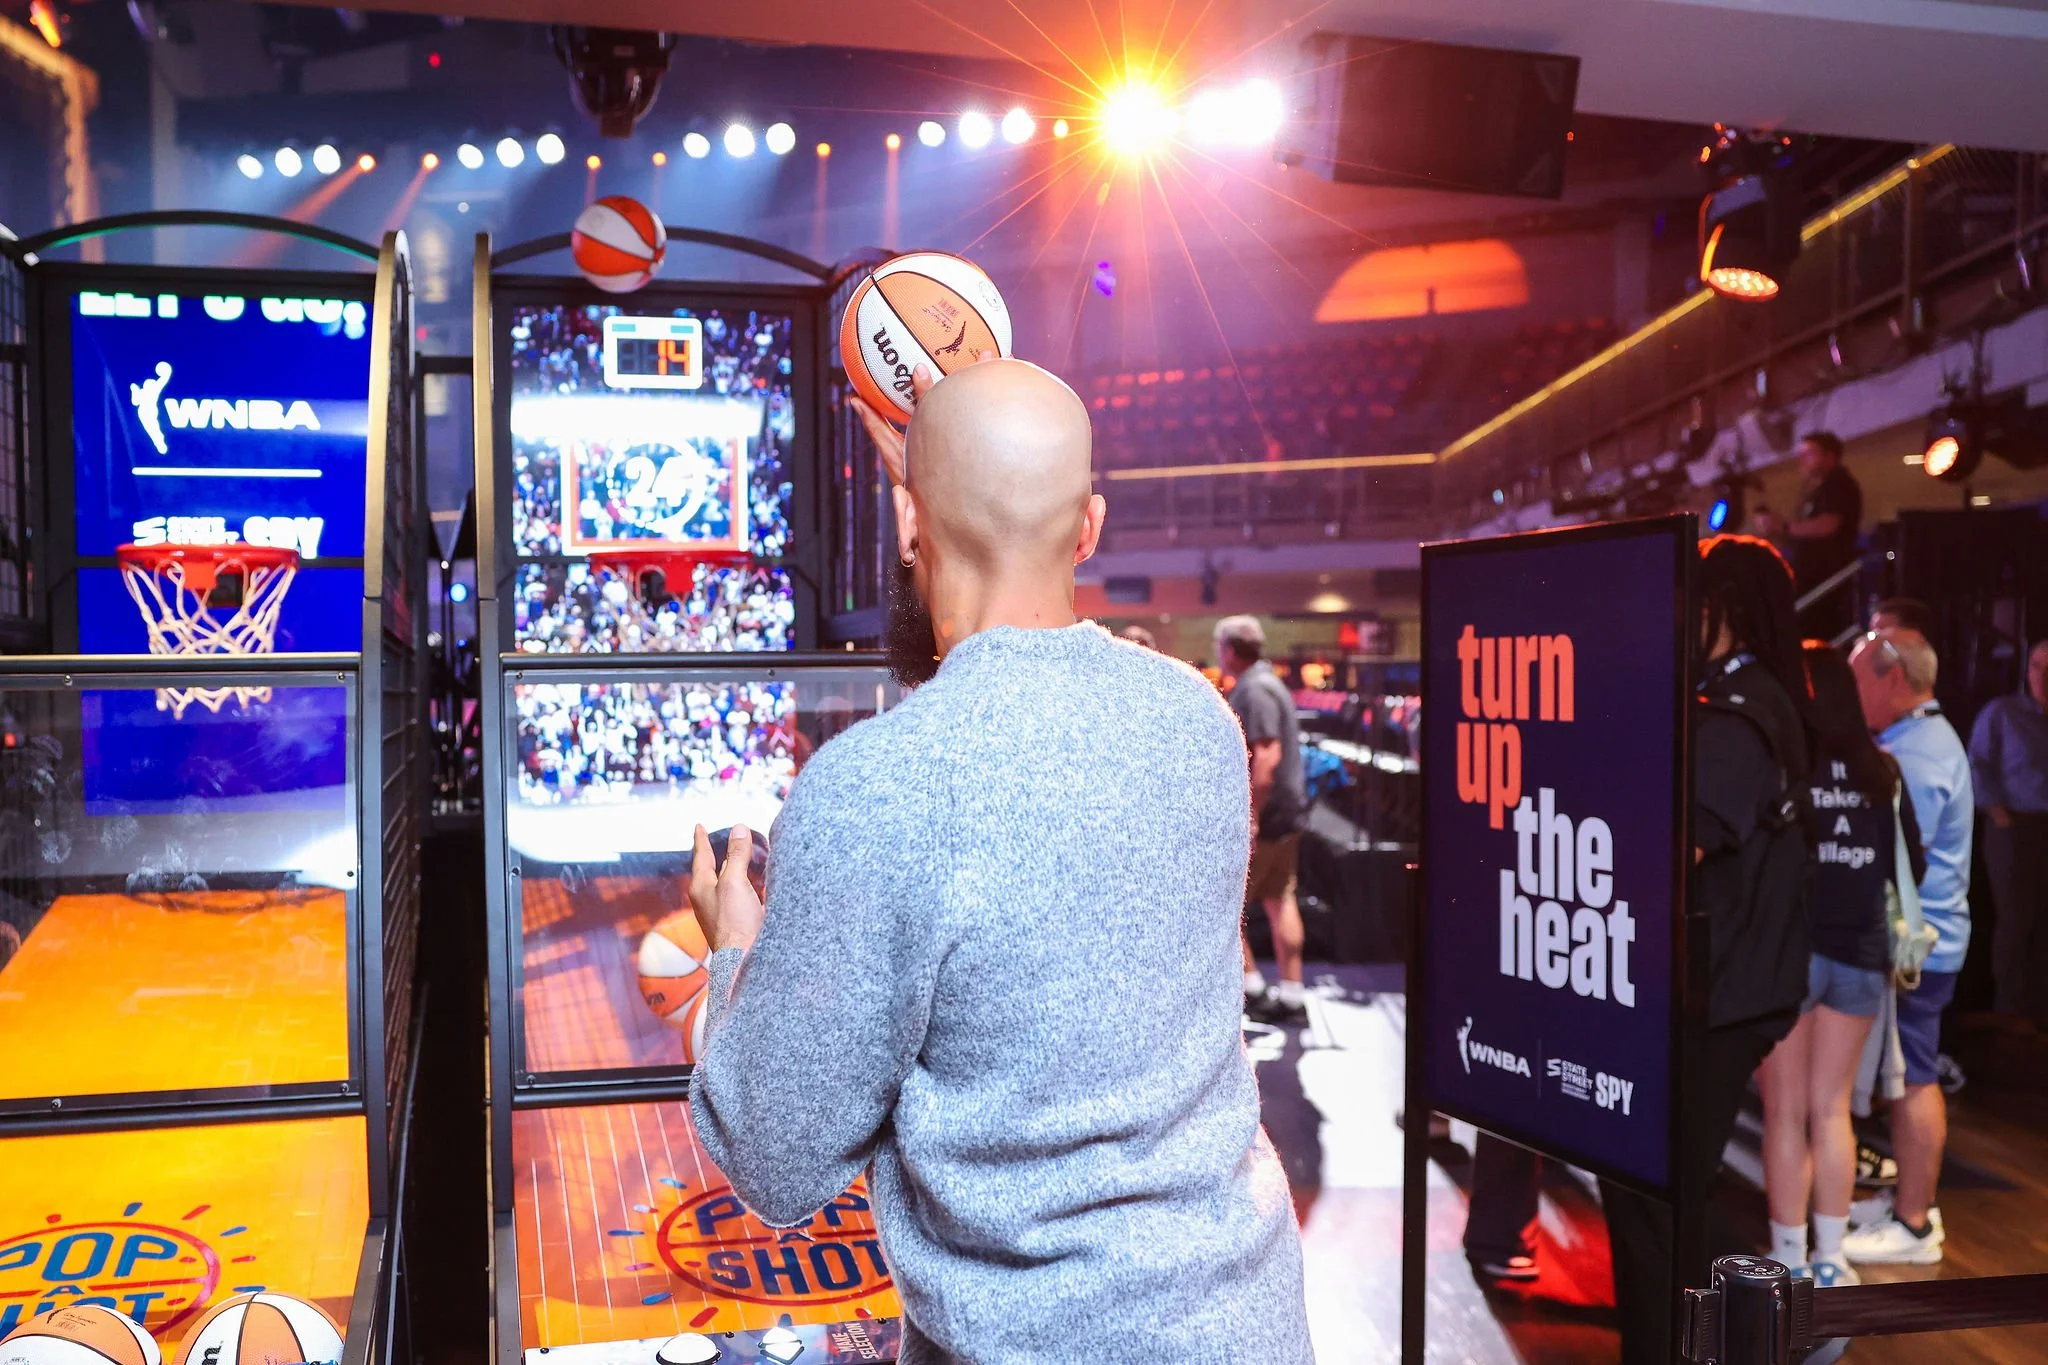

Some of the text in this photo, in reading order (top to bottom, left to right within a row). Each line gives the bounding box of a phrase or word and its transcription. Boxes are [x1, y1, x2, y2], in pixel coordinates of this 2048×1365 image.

[873, 326, 918, 406] lson
[164, 398, 321, 430] WNBA
[1457, 624, 1575, 722] turn
[1457, 722, 1522, 830] up
[1810, 786, 1871, 808] Take
[1833, 814, 1851, 836] A
[1513, 787, 1614, 909] the
[1818, 841, 1876, 869] illage
[1500, 869, 1636, 1008] heat
[1469, 1040, 1532, 1079] WNBA
[1561, 1060, 1587, 1077] STATE
[1561, 1073, 1593, 1090] STREET
[1595, 1071, 1634, 1116] SPY
[694, 1192, 871, 1236] PP
[707, 1241, 889, 1295] SHOT
[832, 1332, 856, 1352] MAKE
[844, 1323, 880, 1360] SELECTION
